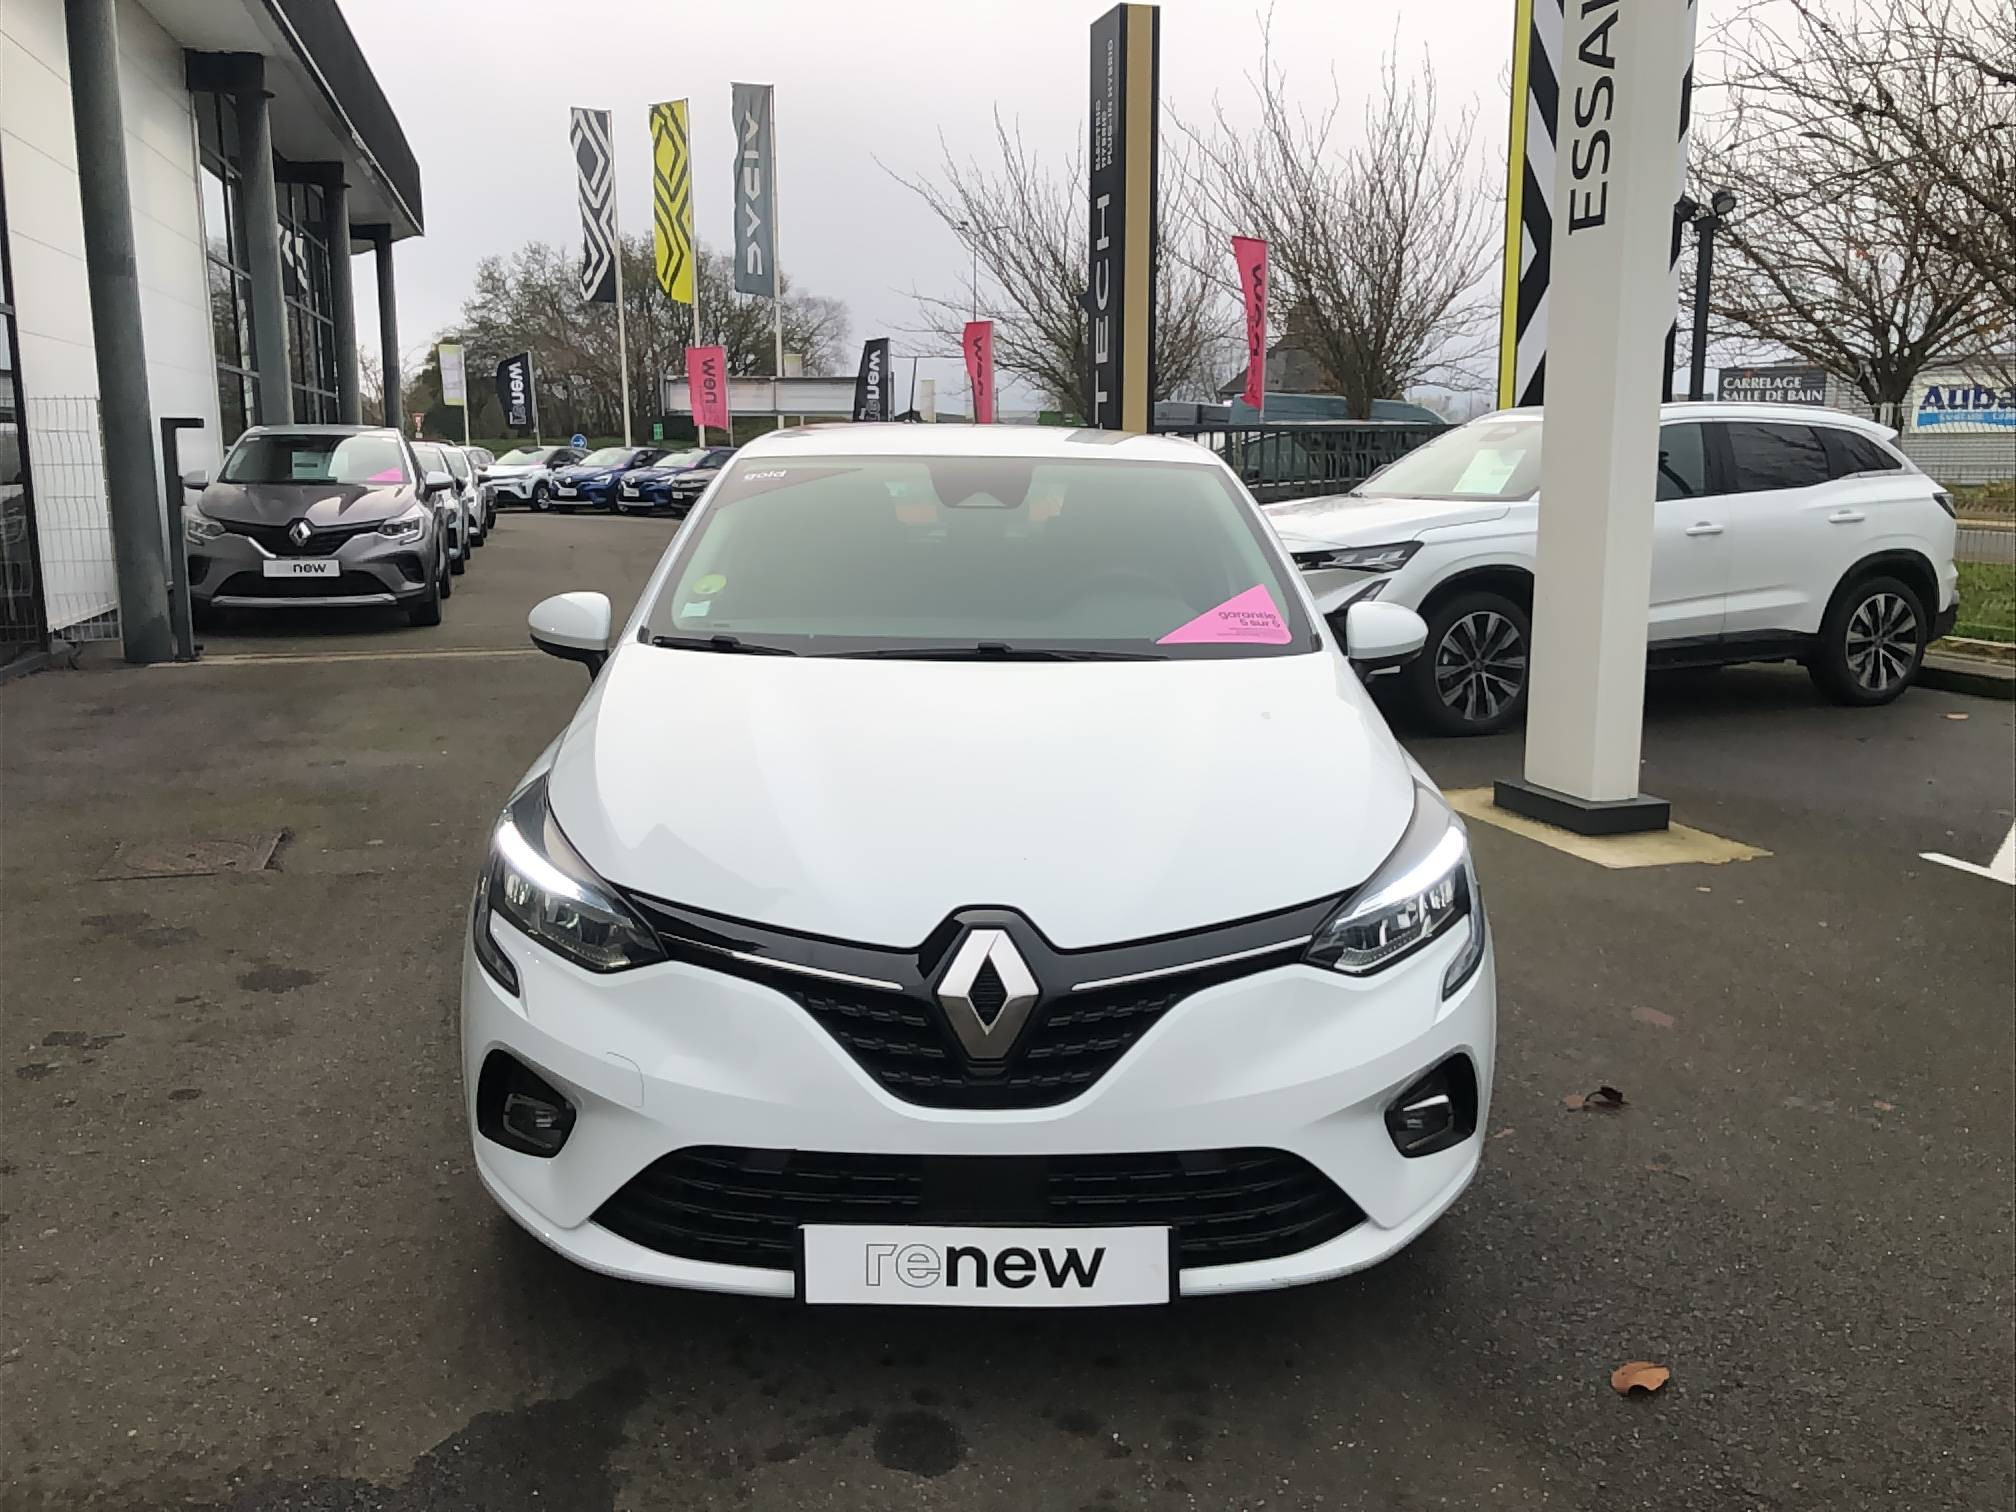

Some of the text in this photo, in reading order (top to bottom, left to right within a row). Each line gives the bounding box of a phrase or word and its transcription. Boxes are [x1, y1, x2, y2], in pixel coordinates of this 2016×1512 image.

[1723, 376, 1802, 389] CARRELAGE
[1722, 388, 1824, 402] SALLE DE BAIN
[744, 468, 787, 481] gold
[1218, 610, 1276, 620] garantie
[866, 1243, 1107, 1290] renew
